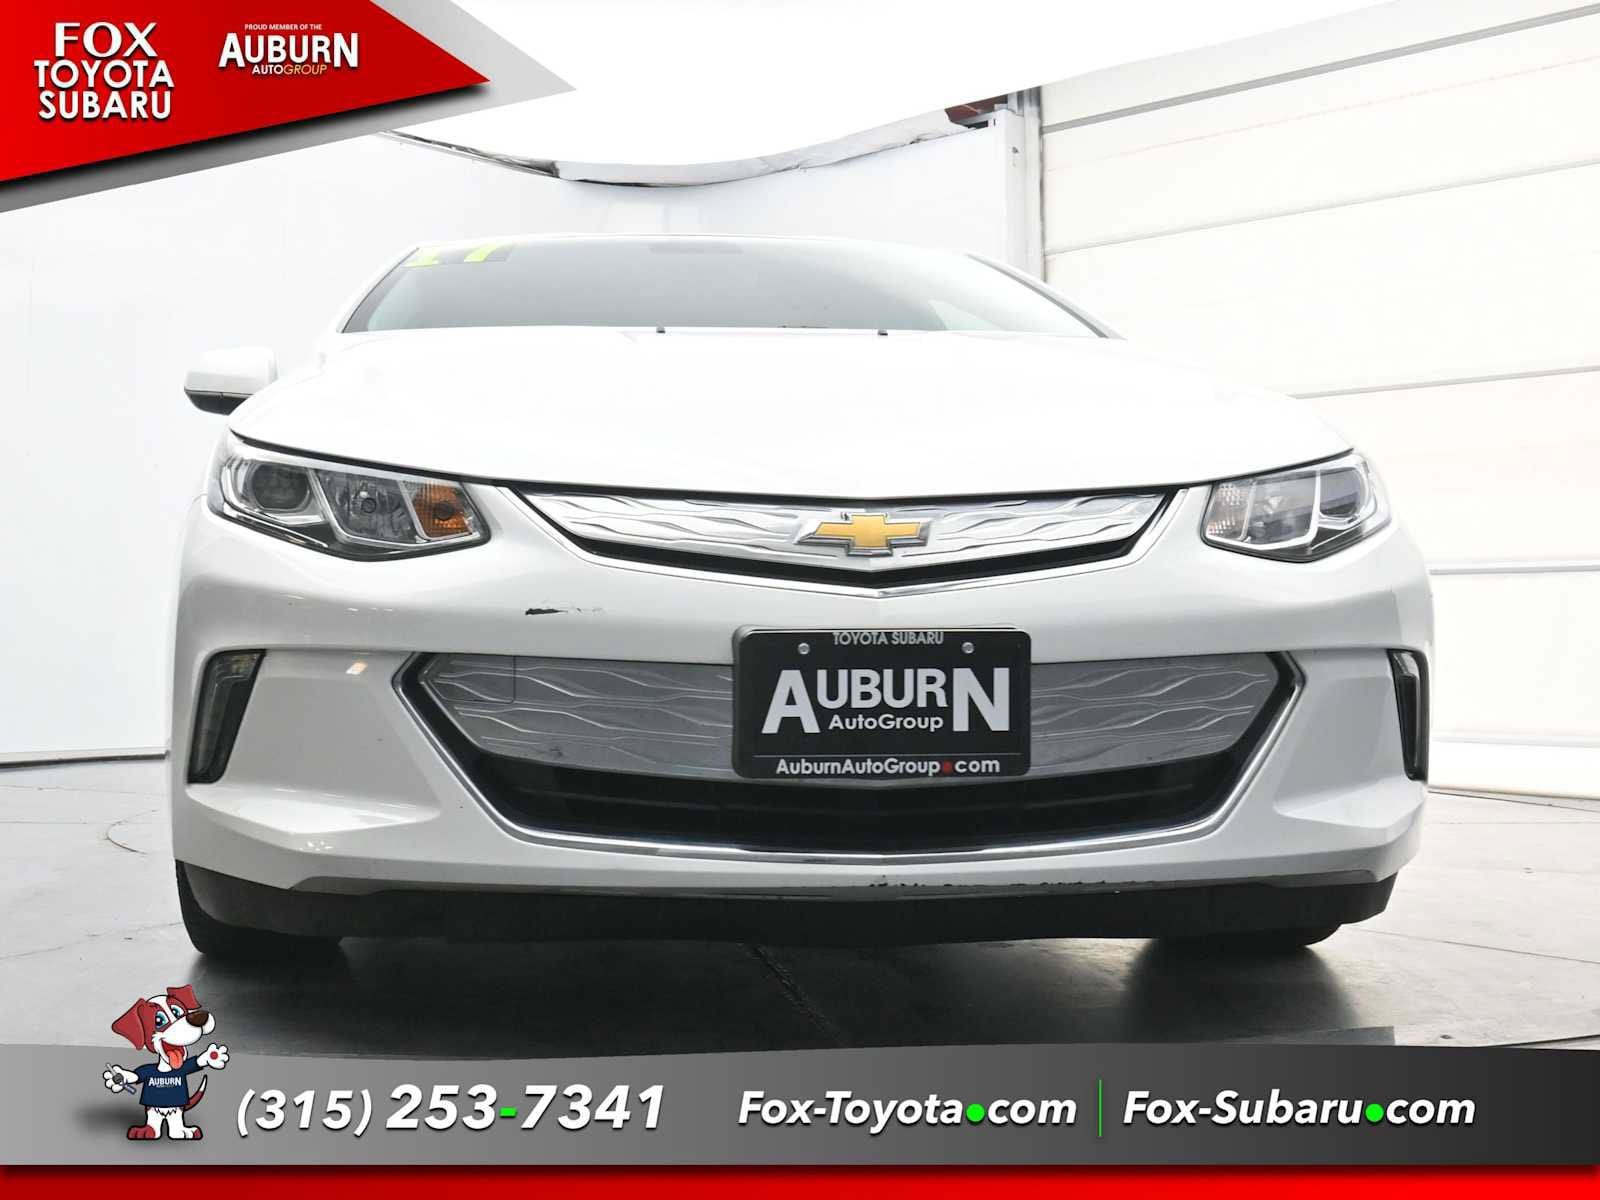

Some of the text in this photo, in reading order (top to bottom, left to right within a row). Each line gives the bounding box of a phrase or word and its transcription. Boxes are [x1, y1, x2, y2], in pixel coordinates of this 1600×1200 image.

[832, 631, 944, 646] TOYOTA SUBARU
[761, 667, 1010, 734] AUBURN
[828, 714, 943, 732] AutoGroup
